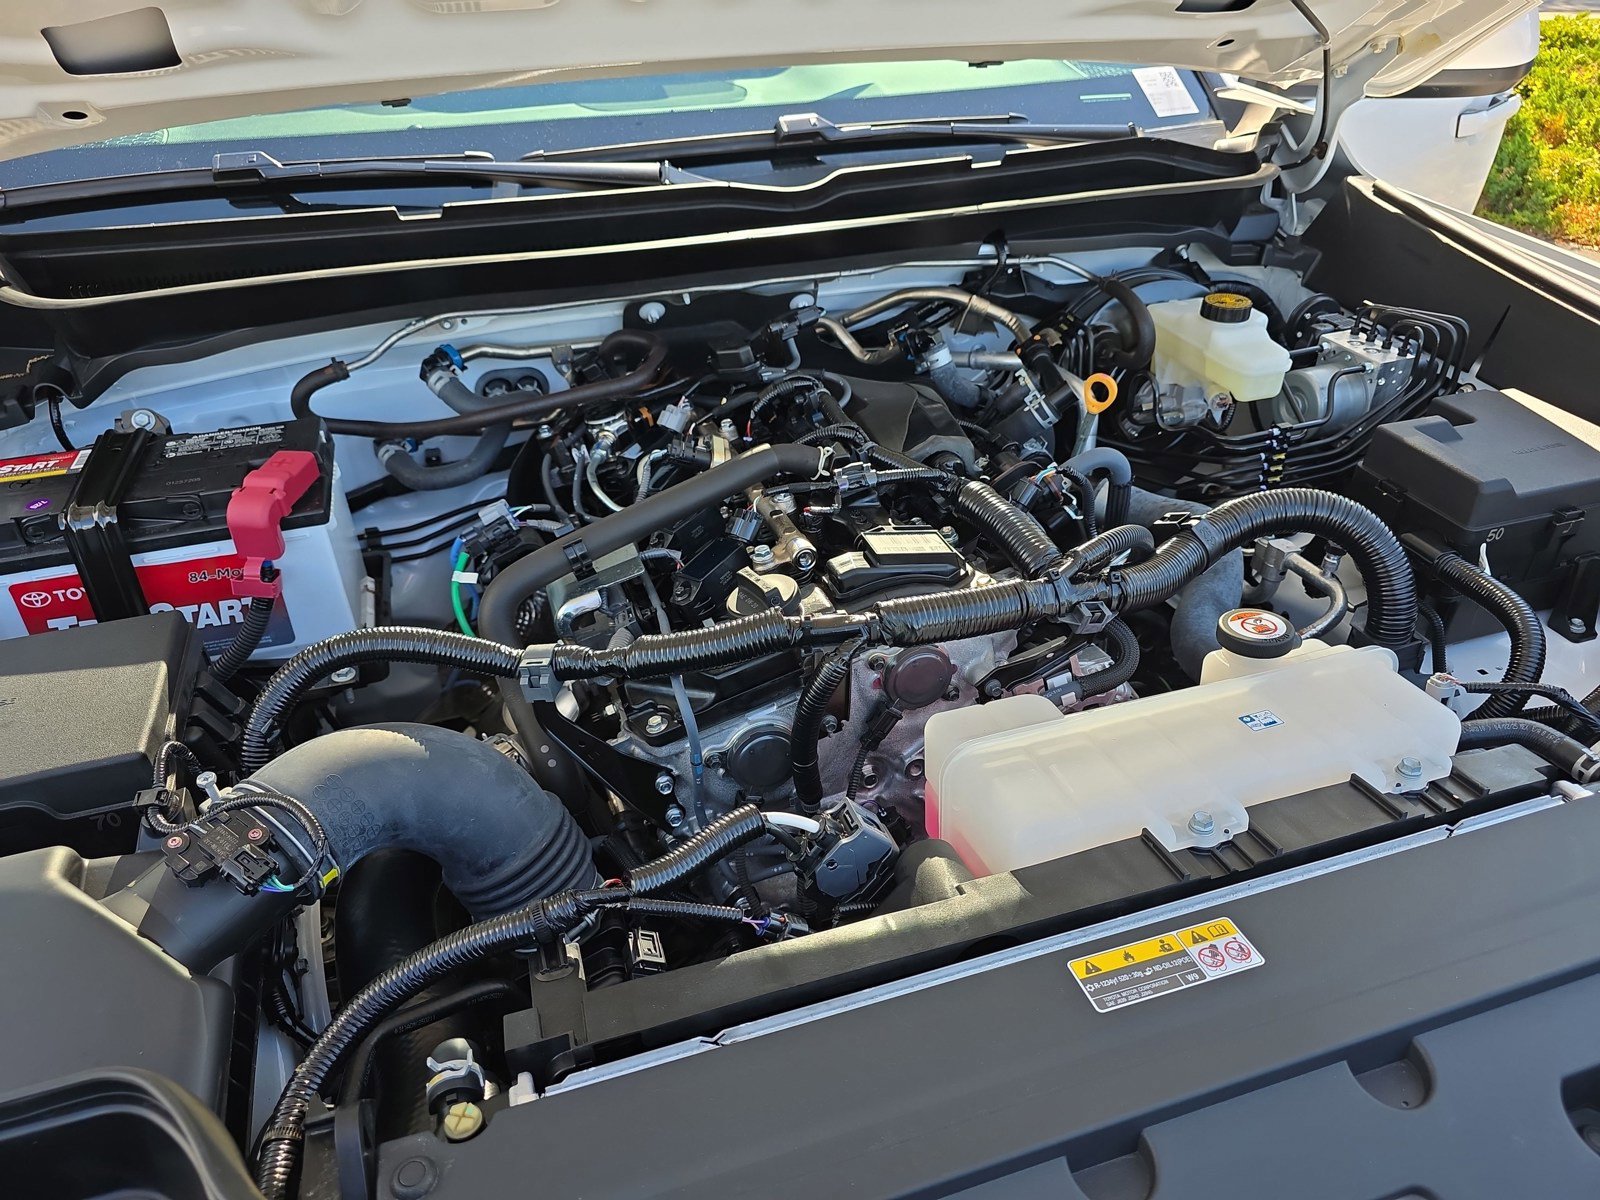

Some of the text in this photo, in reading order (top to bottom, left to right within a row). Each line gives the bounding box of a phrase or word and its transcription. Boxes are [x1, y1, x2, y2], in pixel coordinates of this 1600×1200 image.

[1486, 527, 1505, 542] 50
[89, 812, 122, 831] 70
[1185, 973, 1199, 982] W9
[1102, 979, 1169, 1002] TOYOTA MOTOR CORPORATION
